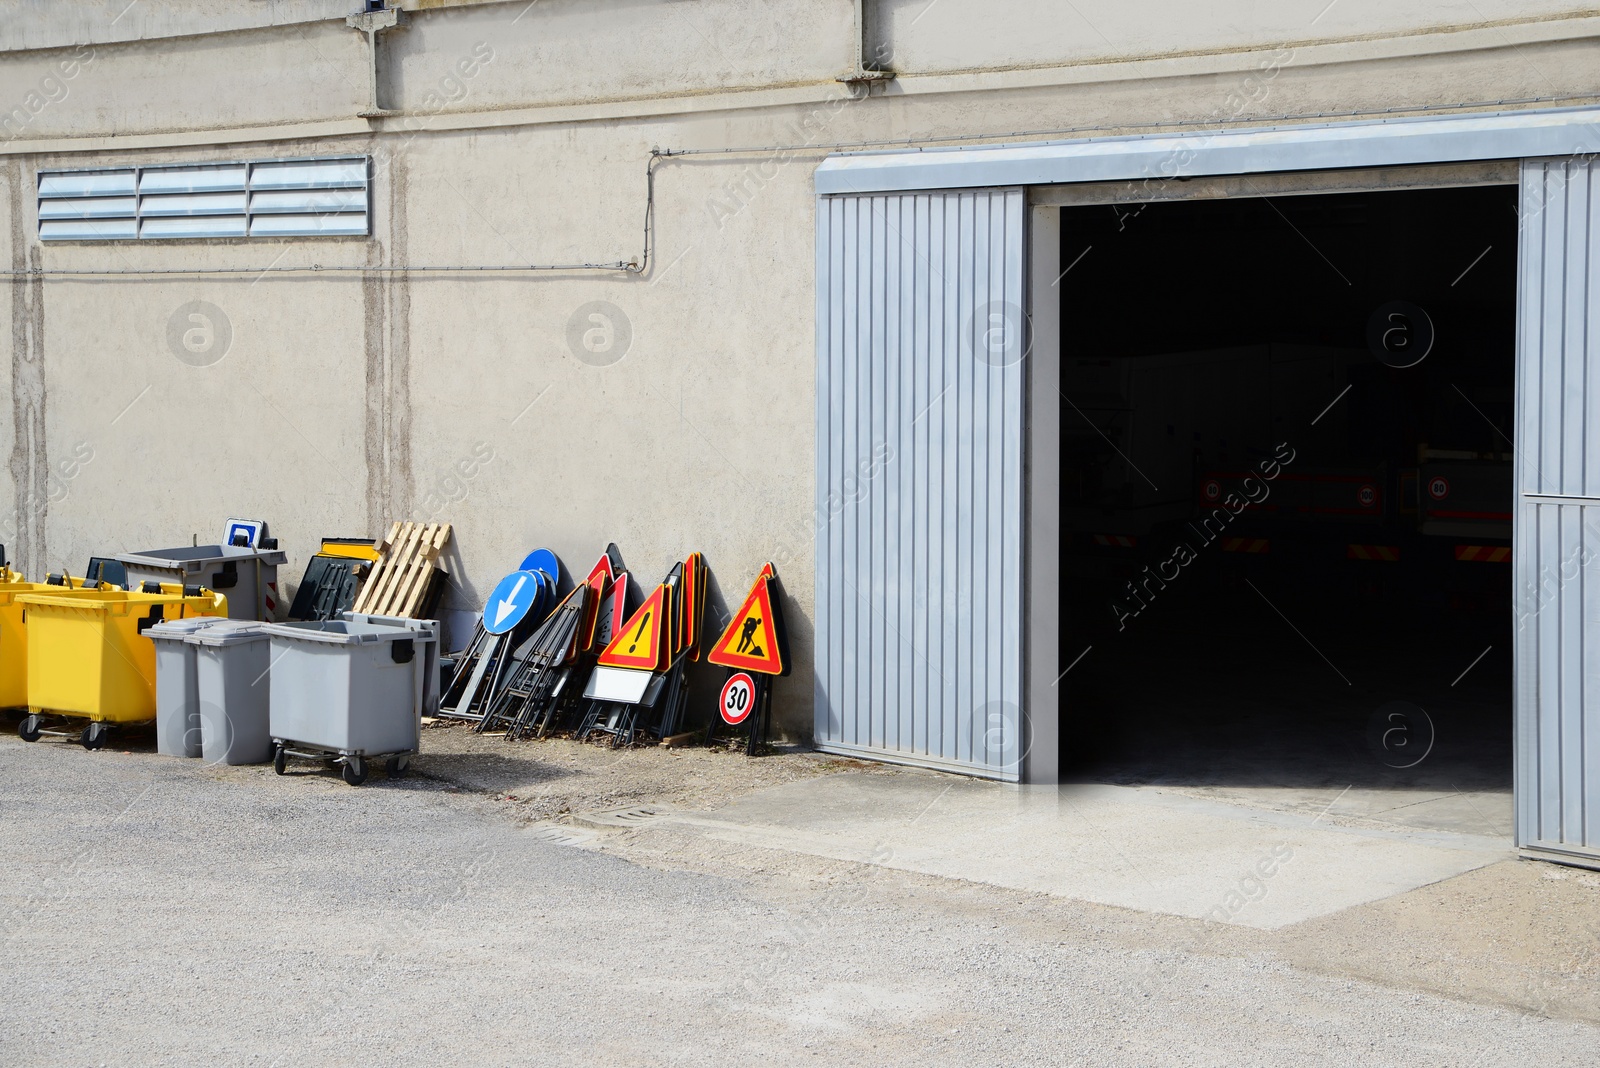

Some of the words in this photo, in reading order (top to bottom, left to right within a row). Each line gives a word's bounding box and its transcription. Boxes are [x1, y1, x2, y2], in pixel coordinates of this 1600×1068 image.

[1434, 484, 1444, 493] 80
[1361, 491, 1373, 500] 100
[727, 686, 747, 711] 30
